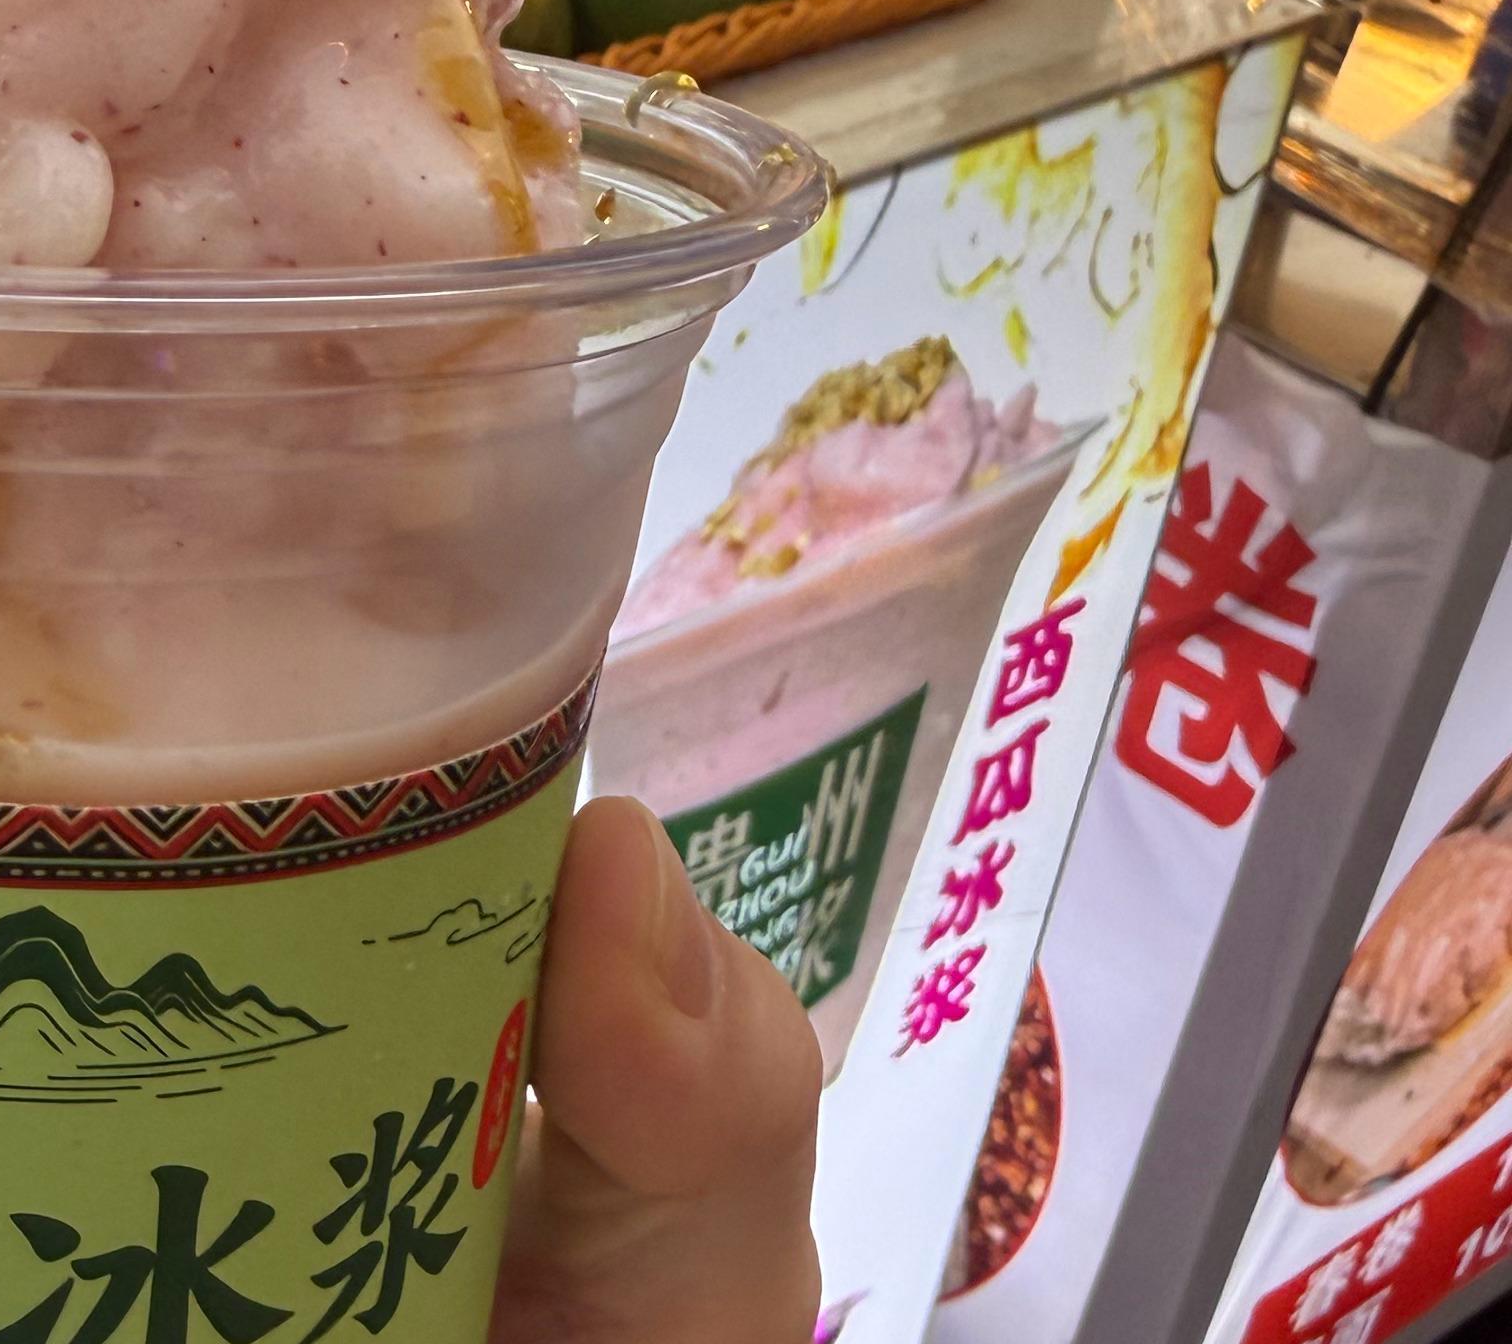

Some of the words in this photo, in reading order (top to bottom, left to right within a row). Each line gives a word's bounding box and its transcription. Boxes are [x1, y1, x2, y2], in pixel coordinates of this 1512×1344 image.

[740, 822, 809, 887] GUI
[891, 596, 1086, 1057] 西瓜冰浆
